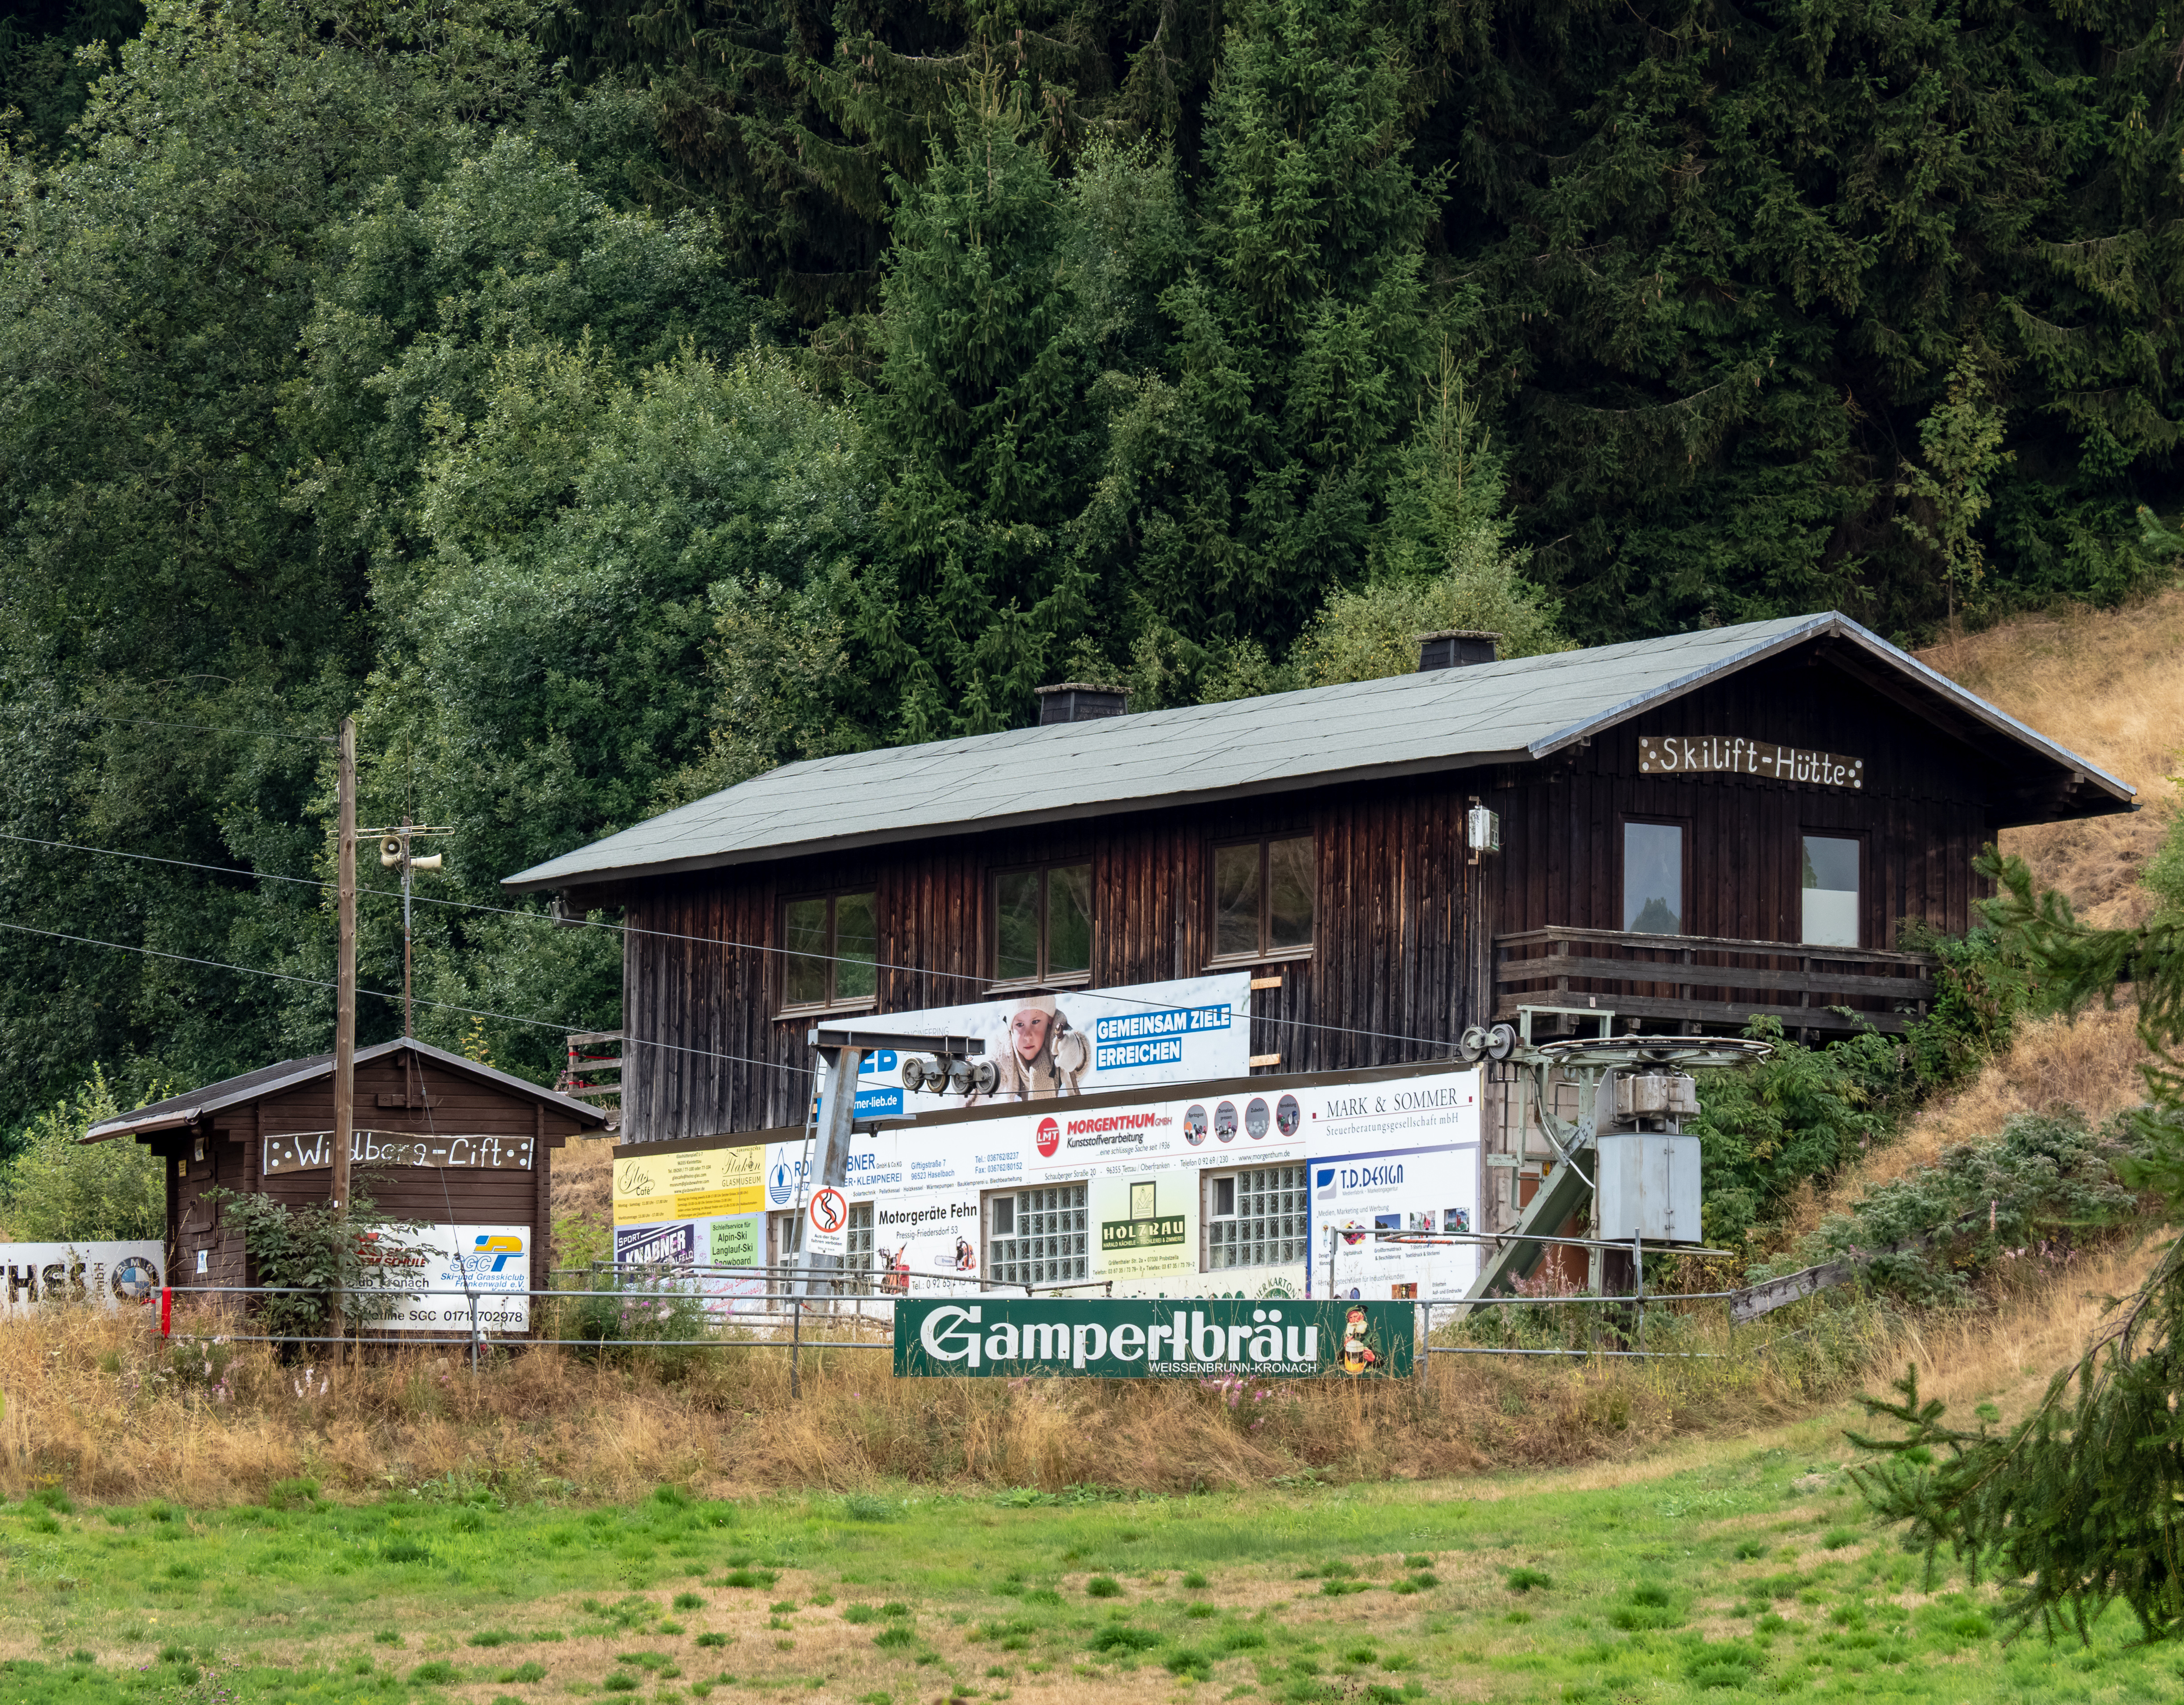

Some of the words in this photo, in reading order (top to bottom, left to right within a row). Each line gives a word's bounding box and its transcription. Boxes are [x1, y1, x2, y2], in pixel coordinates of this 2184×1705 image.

[1661, 738, 1845, 785] Skilift-Hütte
[1098, 1012, 1186, 1039] GEMEINSAM
[1191, 1007, 1229, 1029] ZIELE
[1098, 1041, 1180, 1067] ERREICHEN
[854, 1096, 897, 1109] rner-lieb.de
[1327, 1097, 1368, 1118] MARK
[1376, 1096, 1386, 1113] &
[1394, 1088, 1457, 1111] SOMMER
[1067, 1113, 1155, 1135] MORGENTHUM
[1327, 1115, 1436, 1136] Steuerberatungsgesellschaft
[1439, 1113, 1458, 1124] mbH
[1037, 1131, 1059, 1142] LMT
[1067, 1133, 1144, 1149] Kunststoffverarbeitung
[847, 1153, 875, 1171] BNER
[987, 1152, 1019, 1162] 036762/8237
[1074, 1169, 1088, 1177] Straße
[1106, 1166, 1121, 1174] 96355
[1122, 1164, 1136, 1173] Tettau
[1141, 1162, 1170, 1171] Oberfranken
[1238, 1150, 1290, 1161] www.morgenthum.de
[911, 1160, 942, 1170] Giftigstraße
[988, 1162, 1022, 1173] 036762/80152
[857, 1173, 902, 1185] KLEMPNEREI
[928, 1170, 955, 1178] Haselbach
[722, 1176, 761, 1187] GLASMUSEUM
[636, 1187, 651, 1196] Café
[879, 1206, 946, 1225] Motorgeräte
[951, 1202, 977, 1218] Fehn
[718, 1231, 747, 1244] Alpin-Ski
[896, 1226, 949, 1240] Pressig-Friedersdorf
[951, 1226, 958, 1234] 53
[1103, 1221, 1184, 1240] HOLZBAU
[618, 1232, 641, 1247] SPORT
[712, 1243, 753, 1256] Langlauf-Ski
[450, 1255, 492, 1272] SGC
[409, 1310, 436, 1321] SGC
[921, 1305, 1317, 1369] Gamperlbräu
[1149, 1362, 1317, 1373] WEISSENBRUNN-KRONACH
